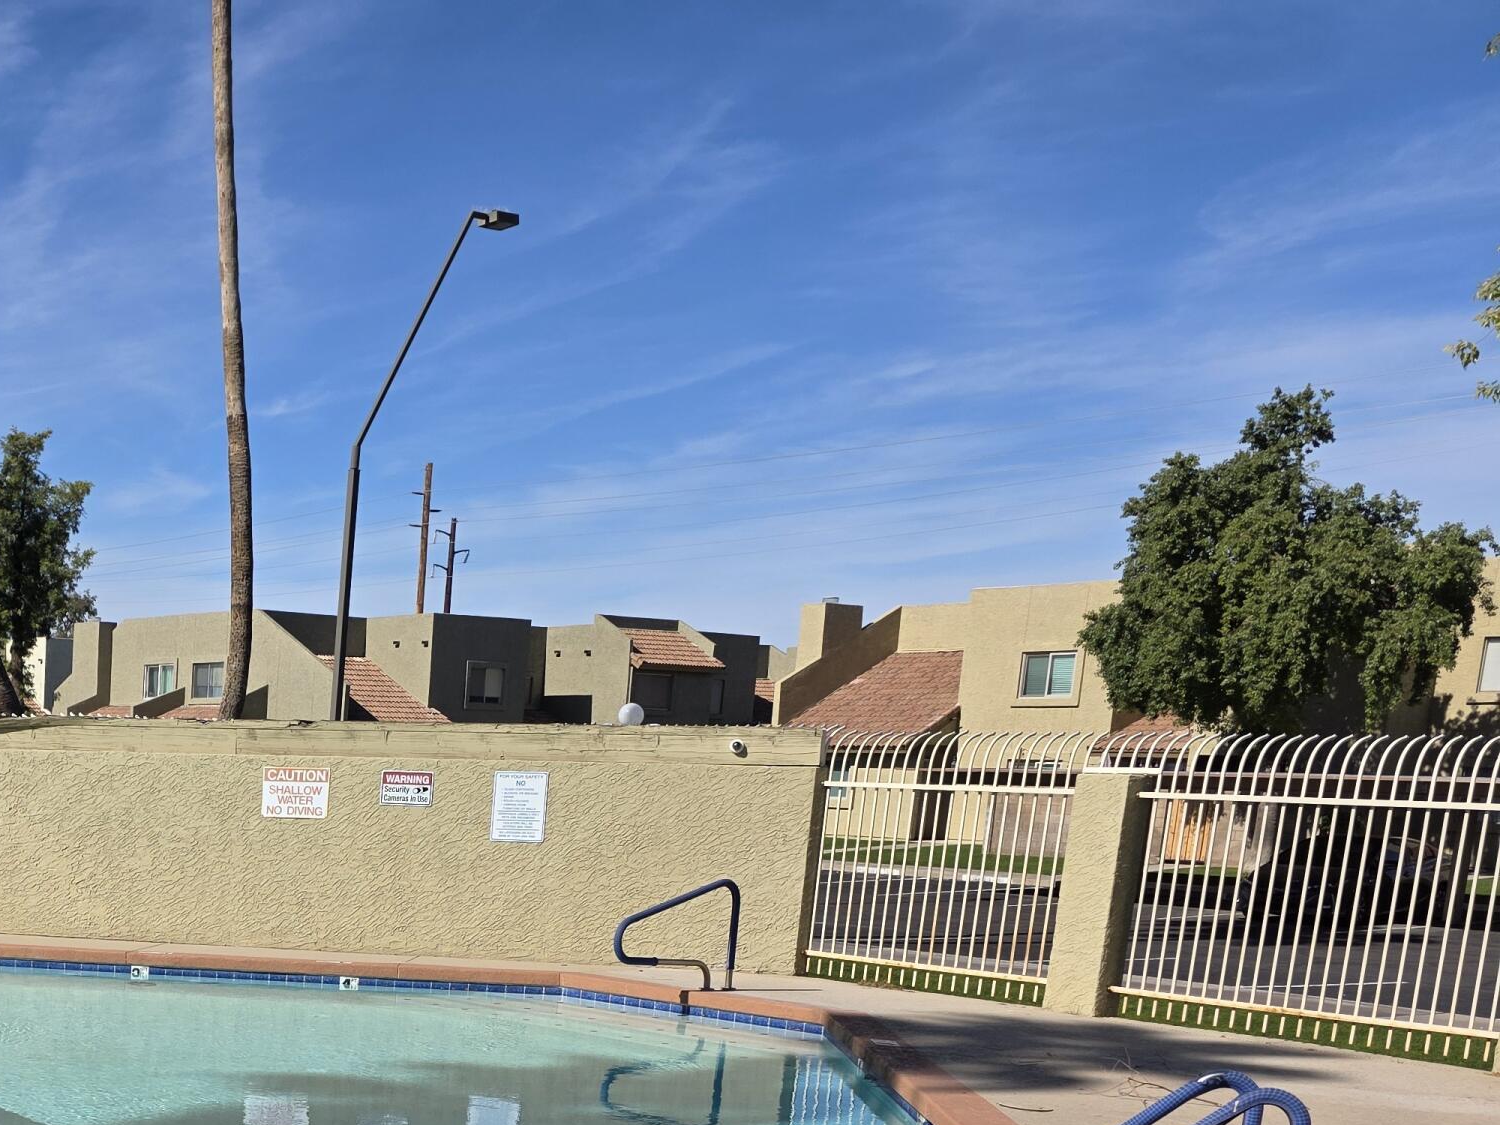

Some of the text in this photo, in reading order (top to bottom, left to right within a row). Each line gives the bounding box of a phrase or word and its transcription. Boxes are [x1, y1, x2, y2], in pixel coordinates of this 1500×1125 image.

[267, 769, 327, 781] CAUTION
[385, 774, 430, 784] WARNING
[268, 784, 323, 796] SHALLOW
[384, 785, 410, 794] Security
[277, 795, 314, 805] WATER
[384, 794, 409, 802] Cameras
[266, 805, 323, 816] NO DIVING
